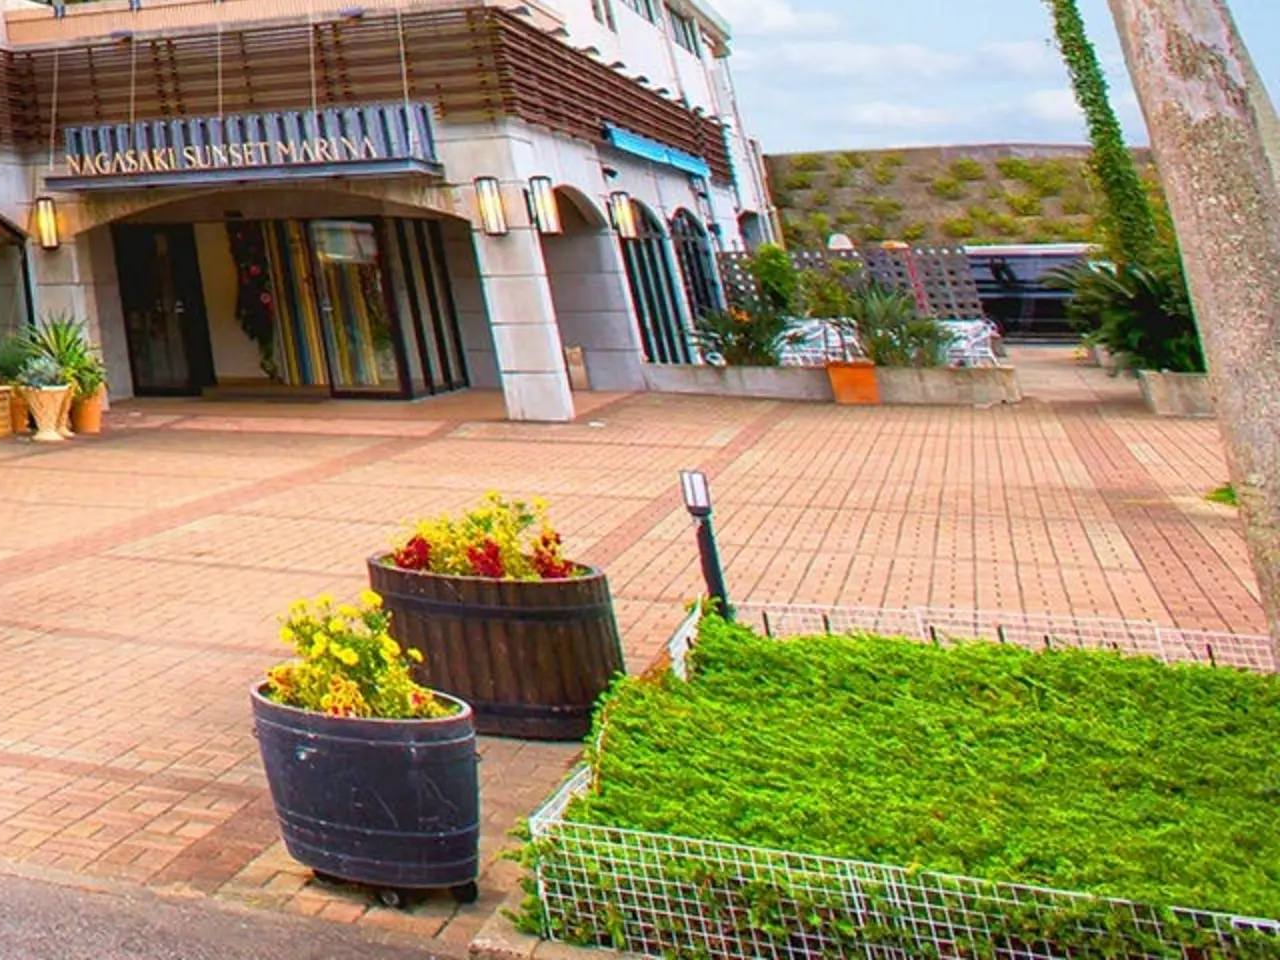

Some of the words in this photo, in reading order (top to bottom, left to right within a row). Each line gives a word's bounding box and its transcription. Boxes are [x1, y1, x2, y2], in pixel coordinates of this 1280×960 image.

[64, 147, 178, 176] NAGASAKI
[183, 141, 268, 170] SUNSET
[276, 136, 377, 164] MARINA
